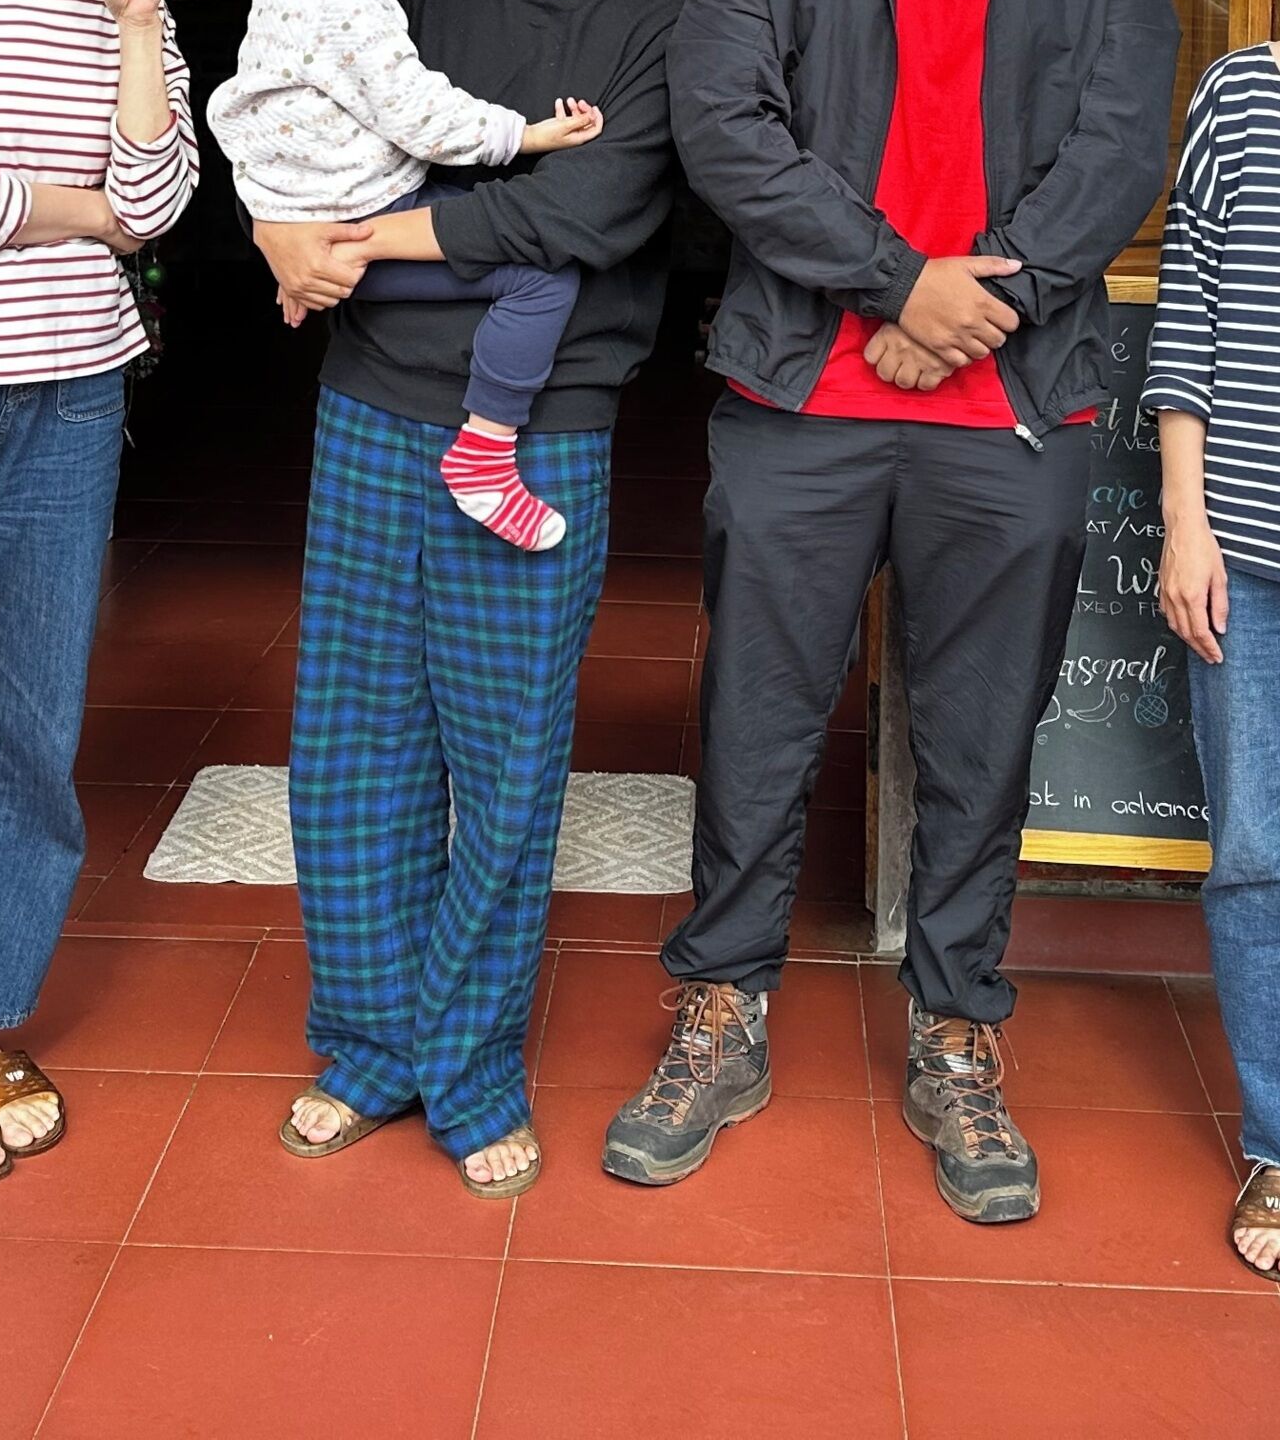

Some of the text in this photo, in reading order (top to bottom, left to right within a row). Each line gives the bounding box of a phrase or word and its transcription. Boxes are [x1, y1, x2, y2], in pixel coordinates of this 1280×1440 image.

[1072, 600, 1124, 616] IXED
[1073, 788, 1092, 809] in
[1111, 790, 1211, 822] advance
[5, 1069, 26, 1083] VIP
